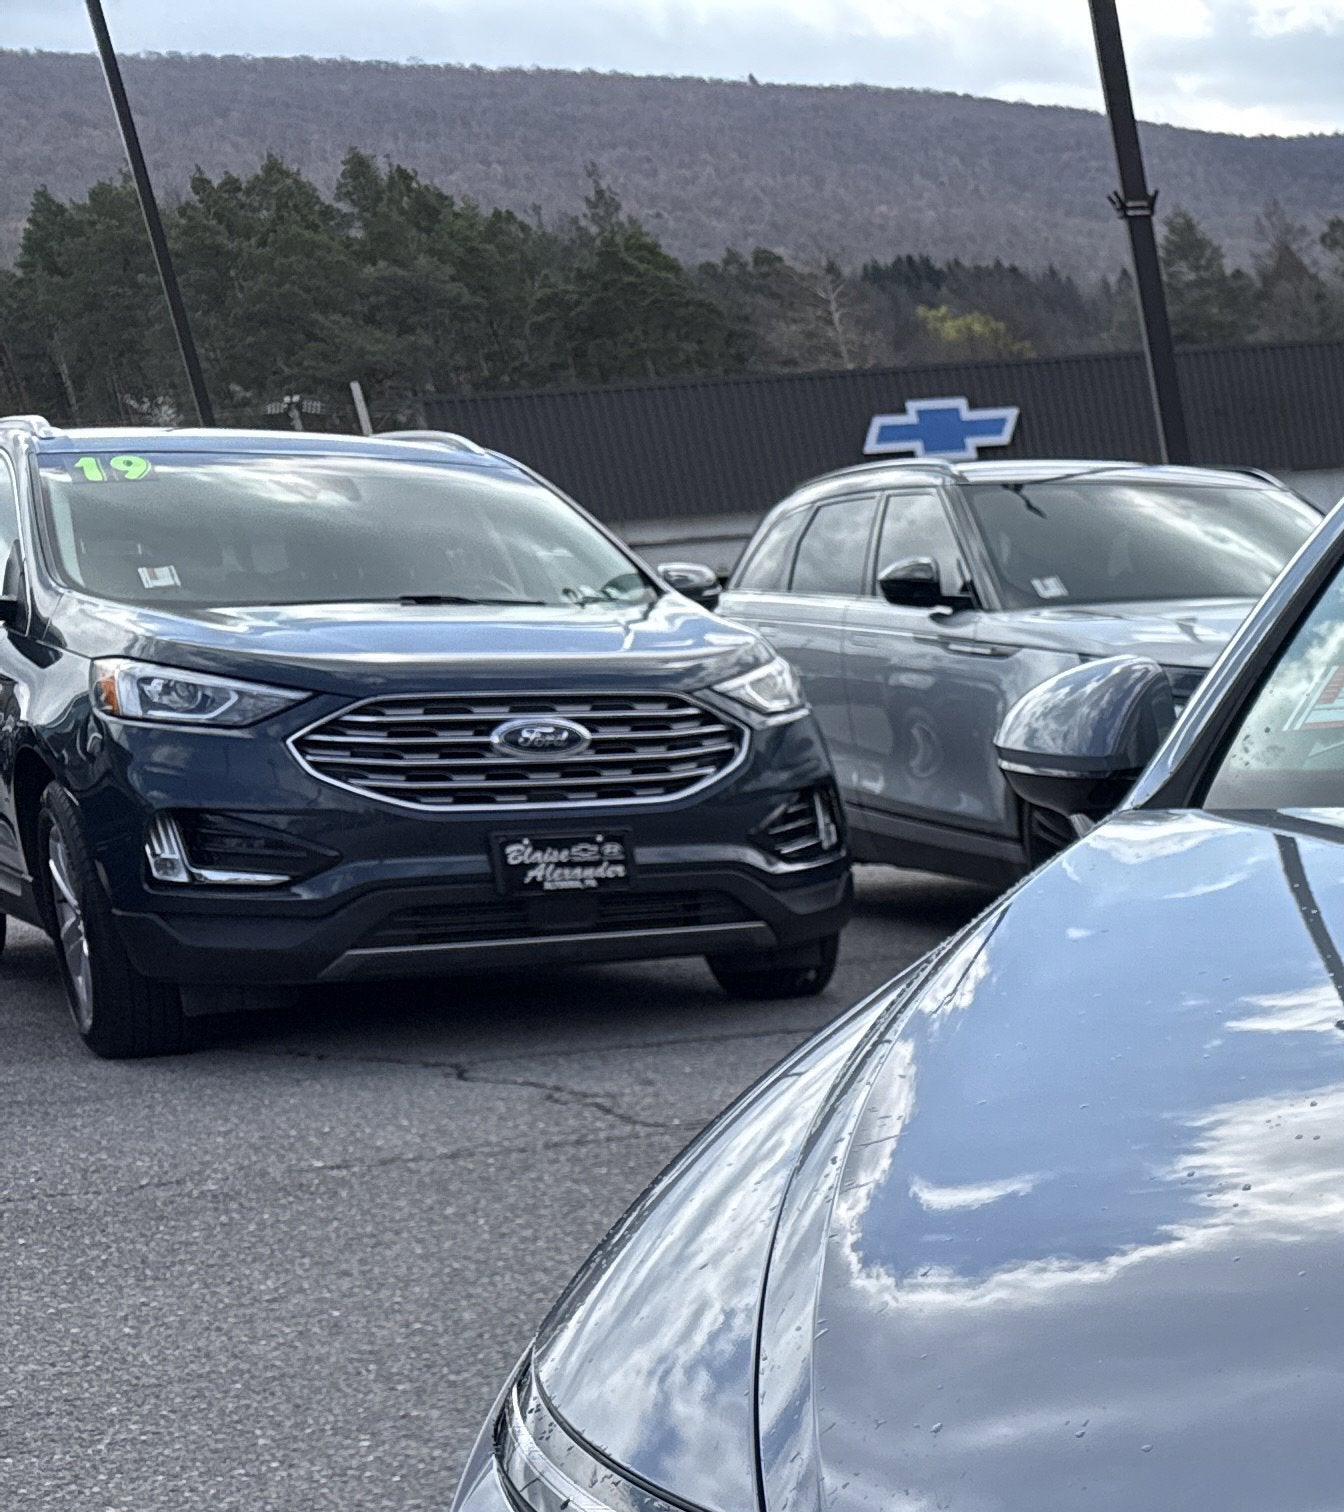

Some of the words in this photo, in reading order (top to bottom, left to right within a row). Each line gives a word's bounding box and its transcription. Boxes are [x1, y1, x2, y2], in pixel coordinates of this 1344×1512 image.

[74, 454, 151, 482] 19
[517, 726, 569, 747] Ford
[504, 843, 570, 865] Blaise
[523, 862, 627, 884] Alexander
